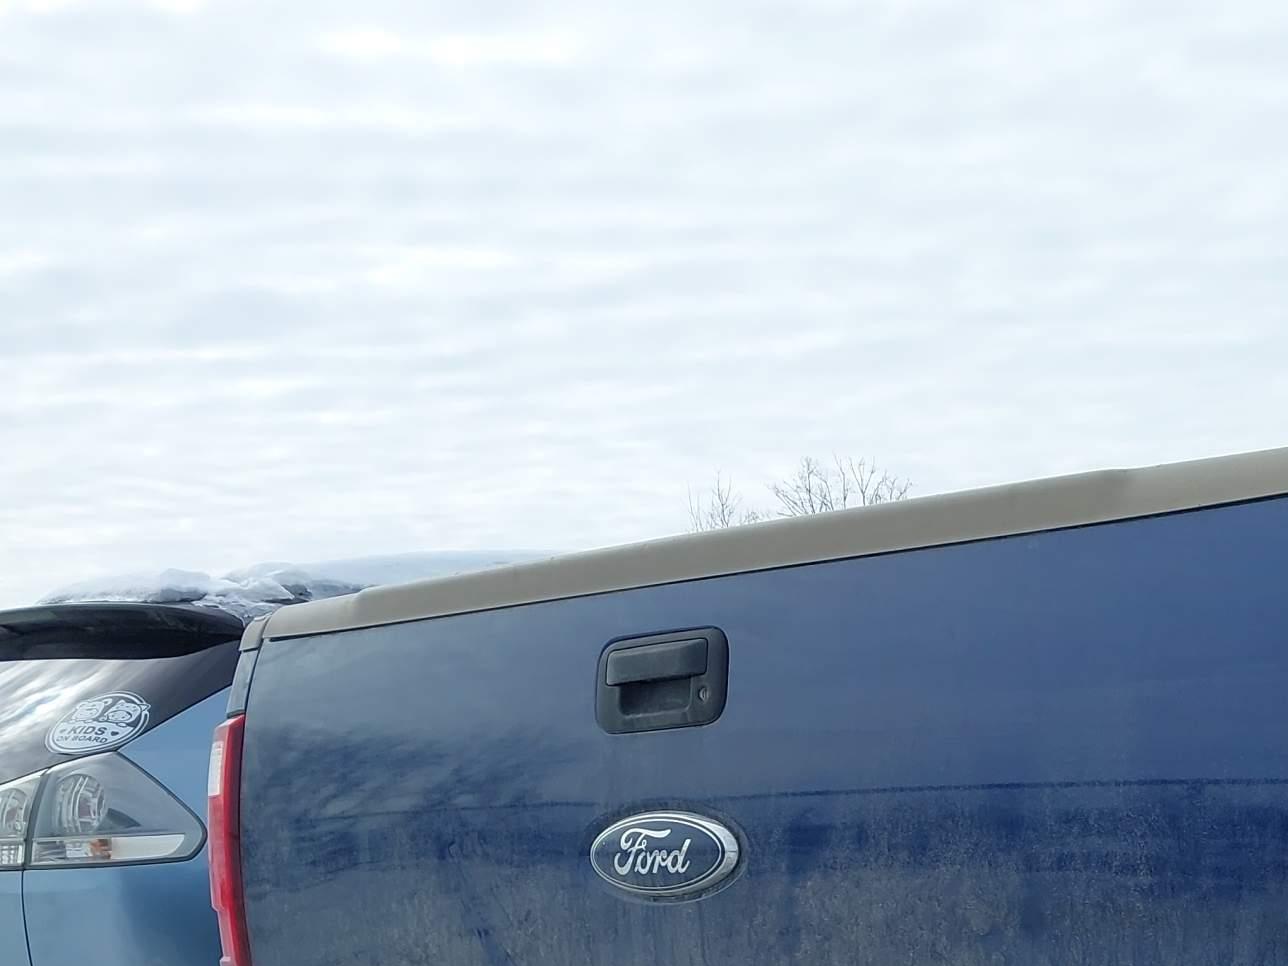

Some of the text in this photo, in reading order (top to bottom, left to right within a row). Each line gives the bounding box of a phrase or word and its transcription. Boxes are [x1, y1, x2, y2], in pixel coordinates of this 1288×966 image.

[67, 725, 107, 736] KIDS
[71, 735, 108, 743] BOARD
[613, 827, 692, 876] Ford
